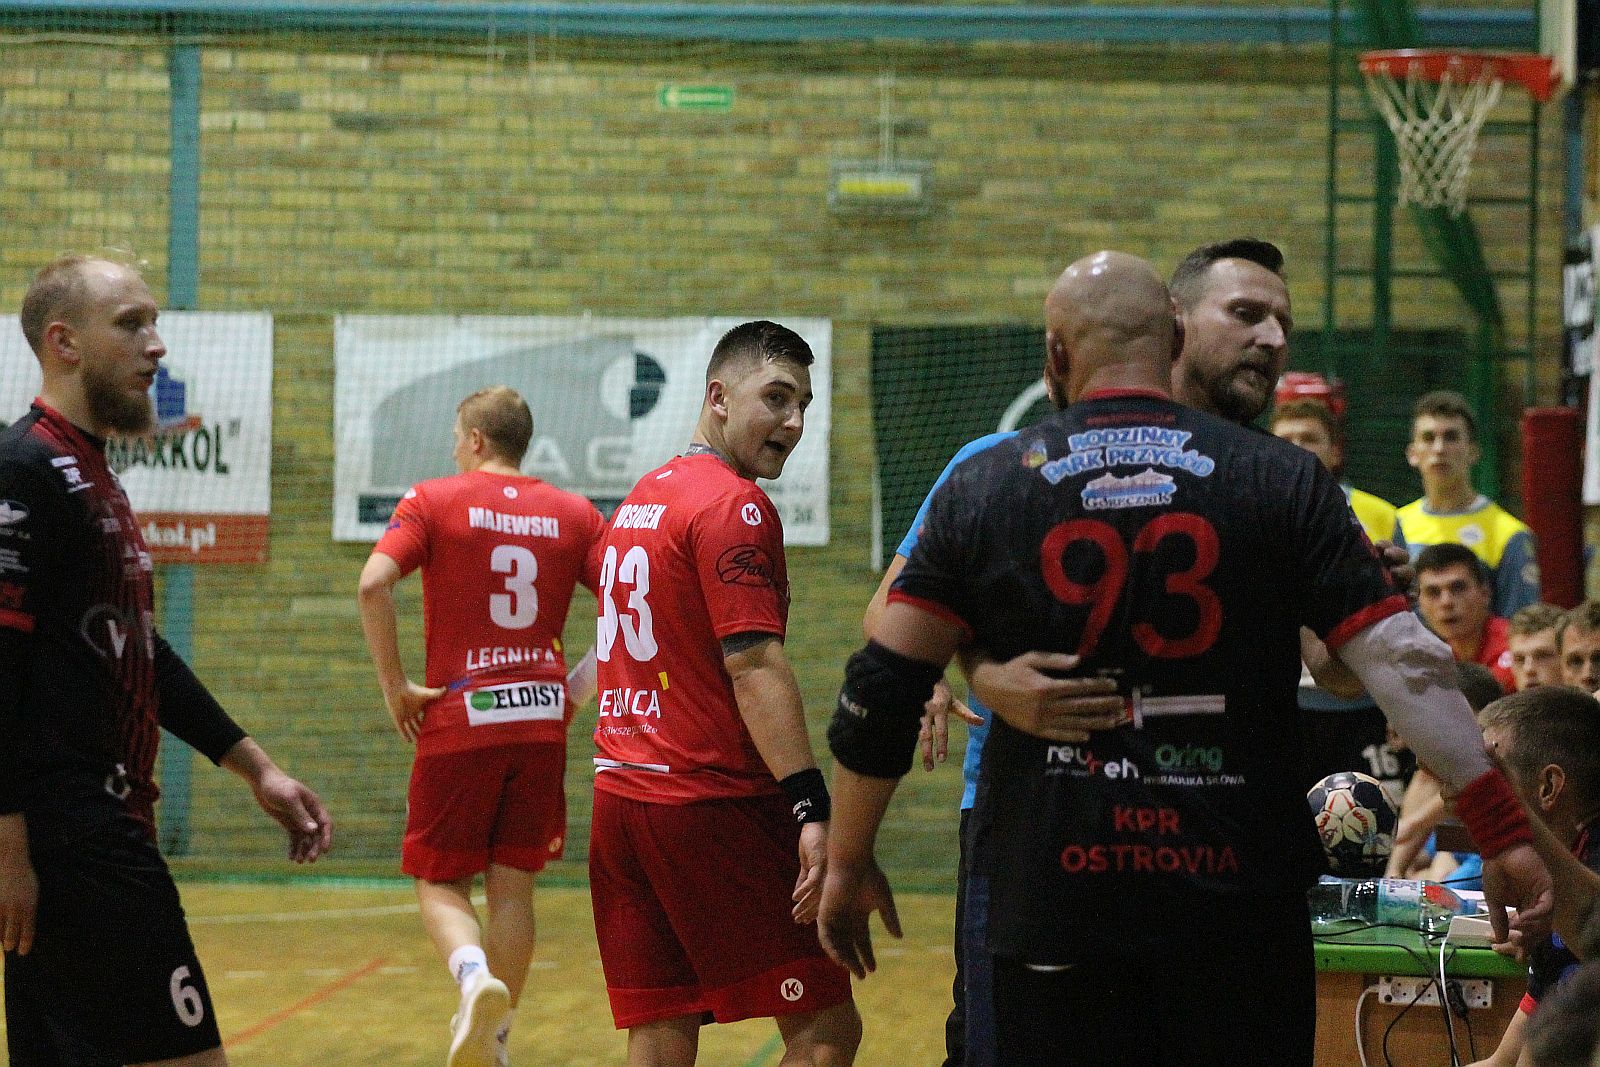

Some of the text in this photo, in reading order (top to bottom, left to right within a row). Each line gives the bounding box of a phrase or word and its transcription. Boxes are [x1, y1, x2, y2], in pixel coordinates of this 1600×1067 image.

[1042, 450, 1102, 484] PARK
[468, 507, 560, 538] MAJEWSKI
[489, 545, 538, 629] 3
[1041, 512, 1222, 657] 93
[495, 684, 562, 709] ELDISY
[1113, 806, 1180, 834] KPR
[1060, 845, 1240, 873] OSTROVIA
[169, 965, 204, 1027] 6
